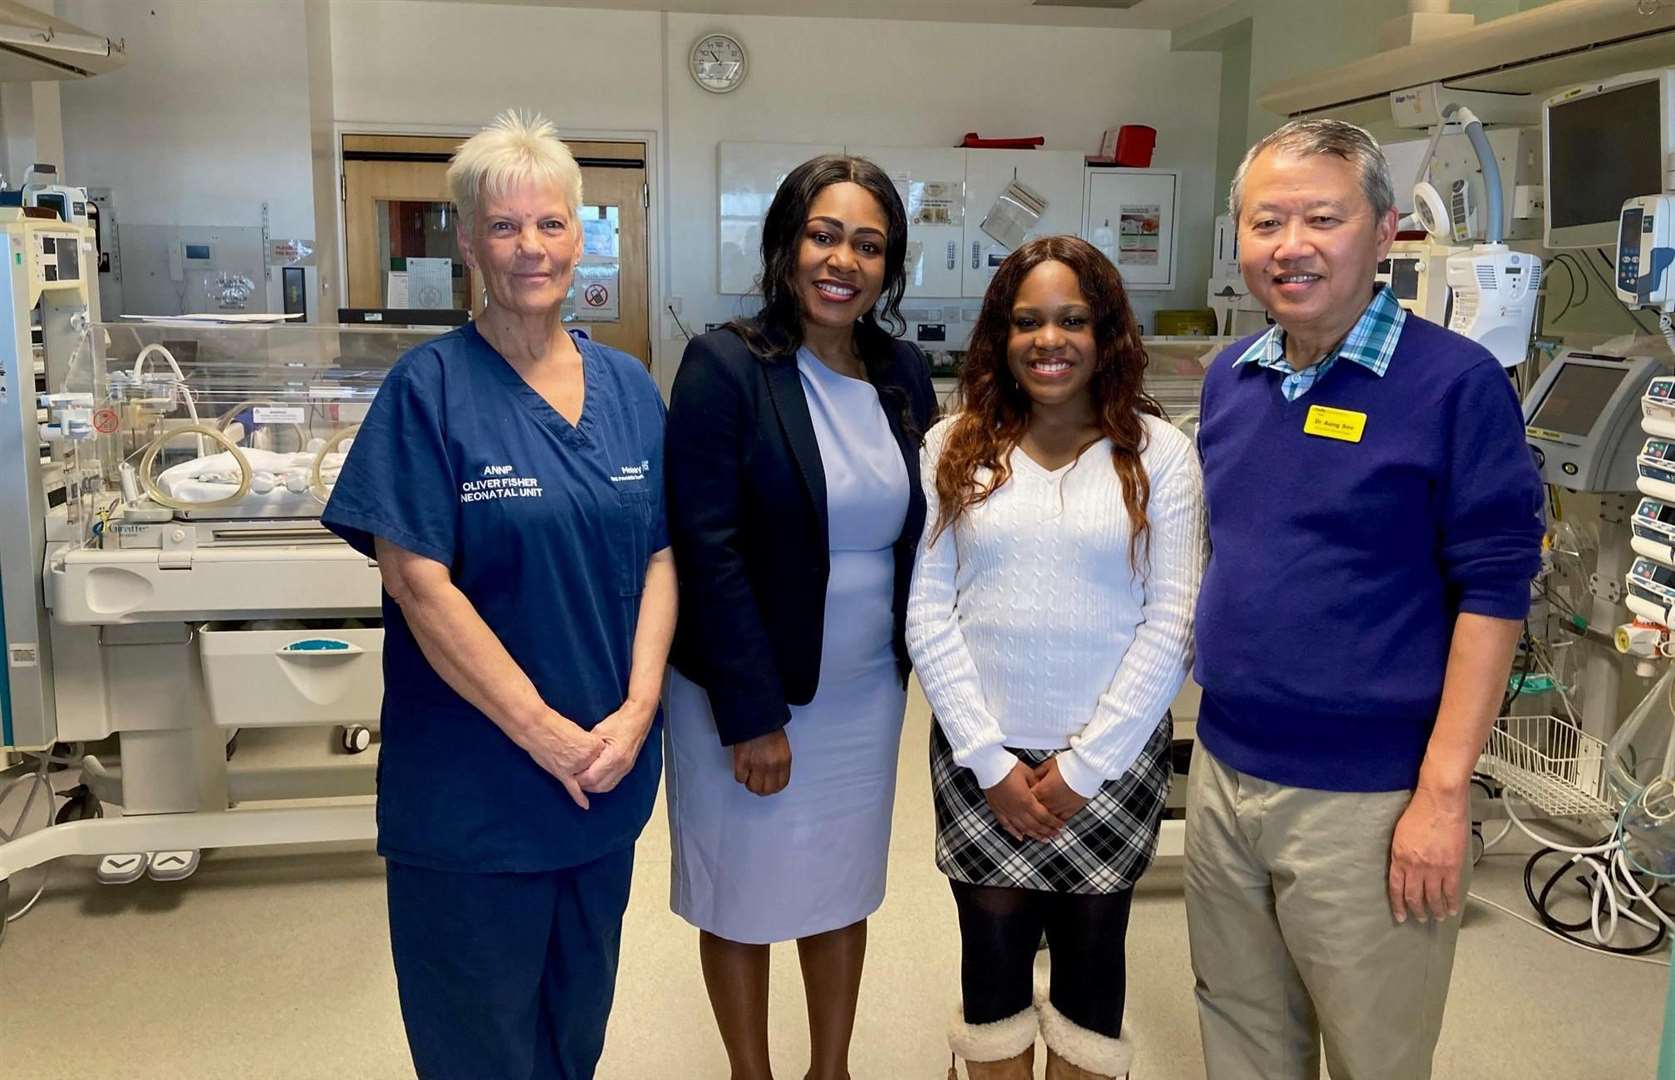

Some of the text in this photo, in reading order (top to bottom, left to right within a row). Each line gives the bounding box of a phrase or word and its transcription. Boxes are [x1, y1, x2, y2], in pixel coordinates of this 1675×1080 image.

[483, 465, 513, 475] ANNP
[462, 478, 538, 491] OLIVER FISHER
[460, 487, 543, 503] NEONATAL UNIT
